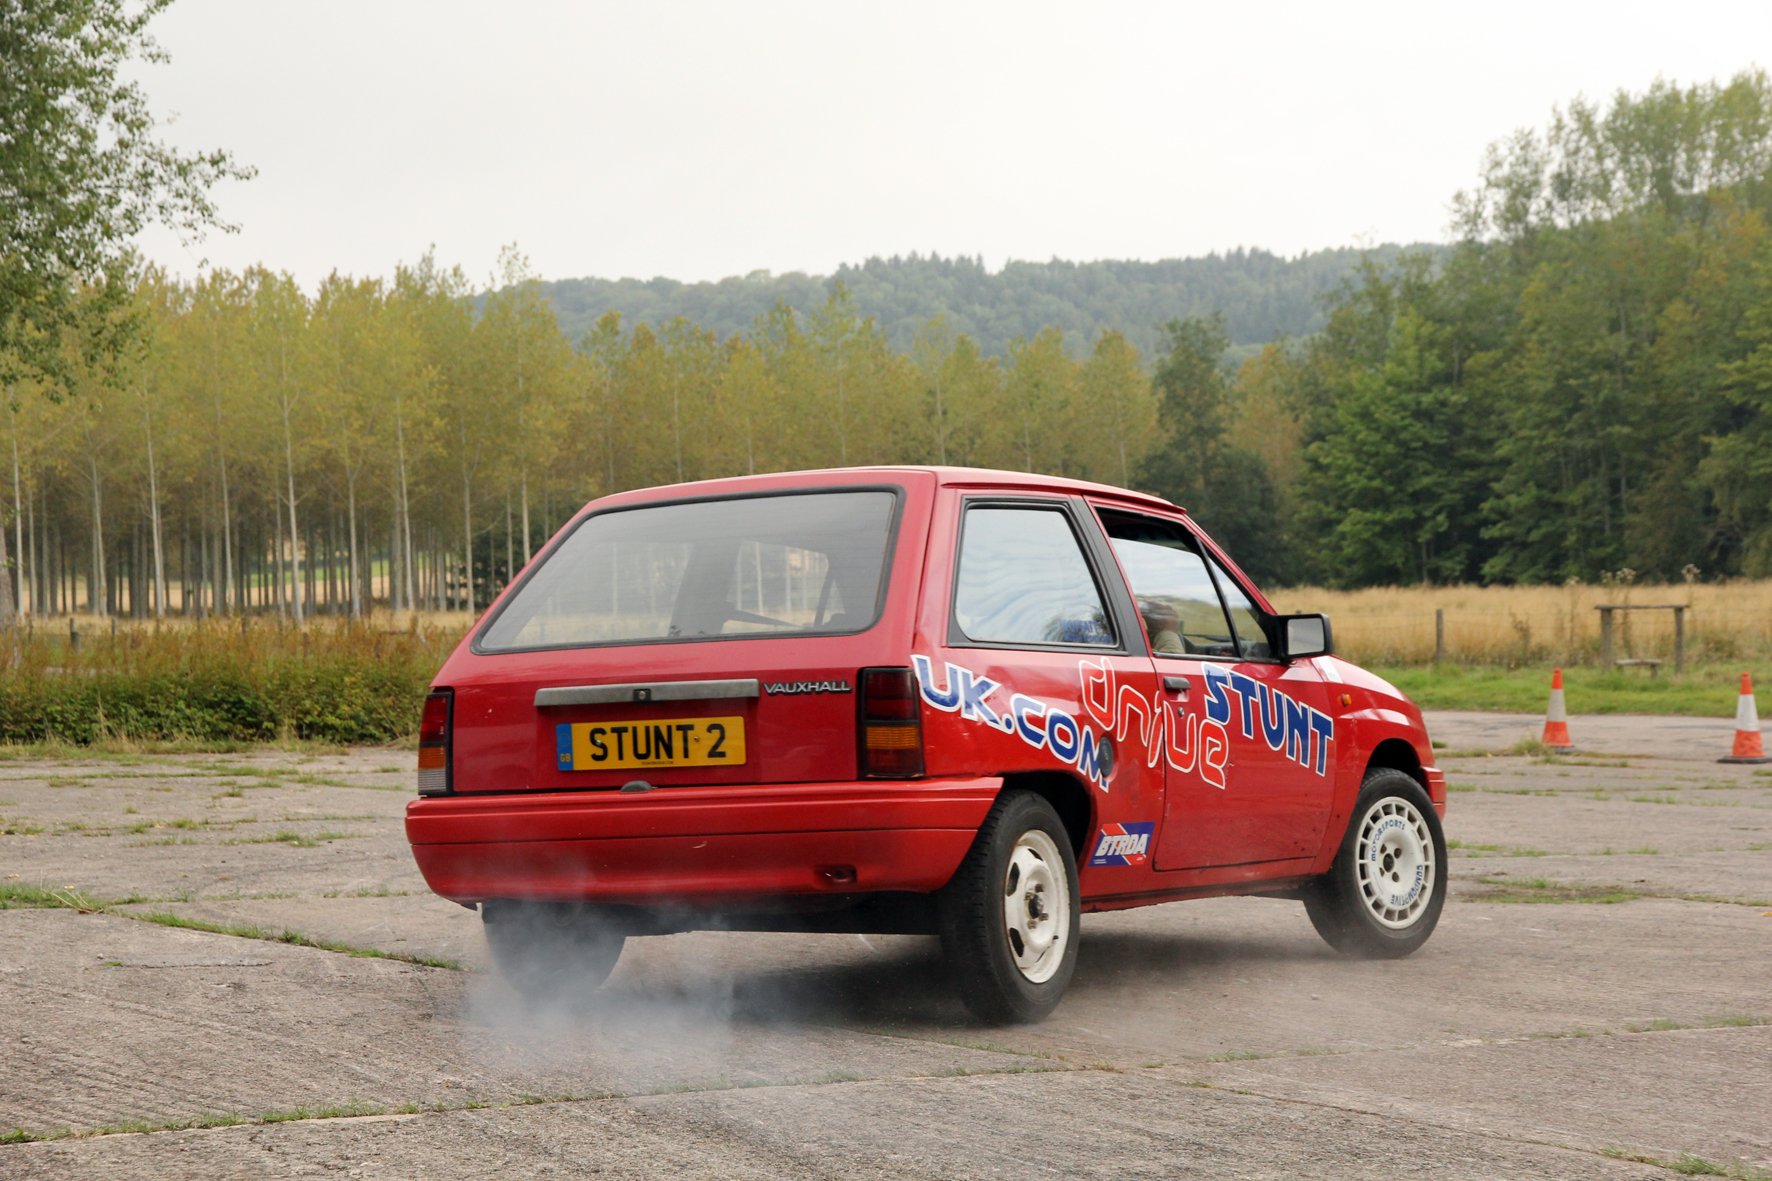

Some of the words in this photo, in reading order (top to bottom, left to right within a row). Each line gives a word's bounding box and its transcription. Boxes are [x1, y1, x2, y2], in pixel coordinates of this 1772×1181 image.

[764, 680, 852, 695] VAUXHALL
[910, 654, 1109, 793] UK.COM
[1201, 661, 1335, 778] STUNT
[589, 724, 695, 762] STUNT
[706, 723, 727, 759] 2
[1094, 833, 1150, 857] BTRDA
